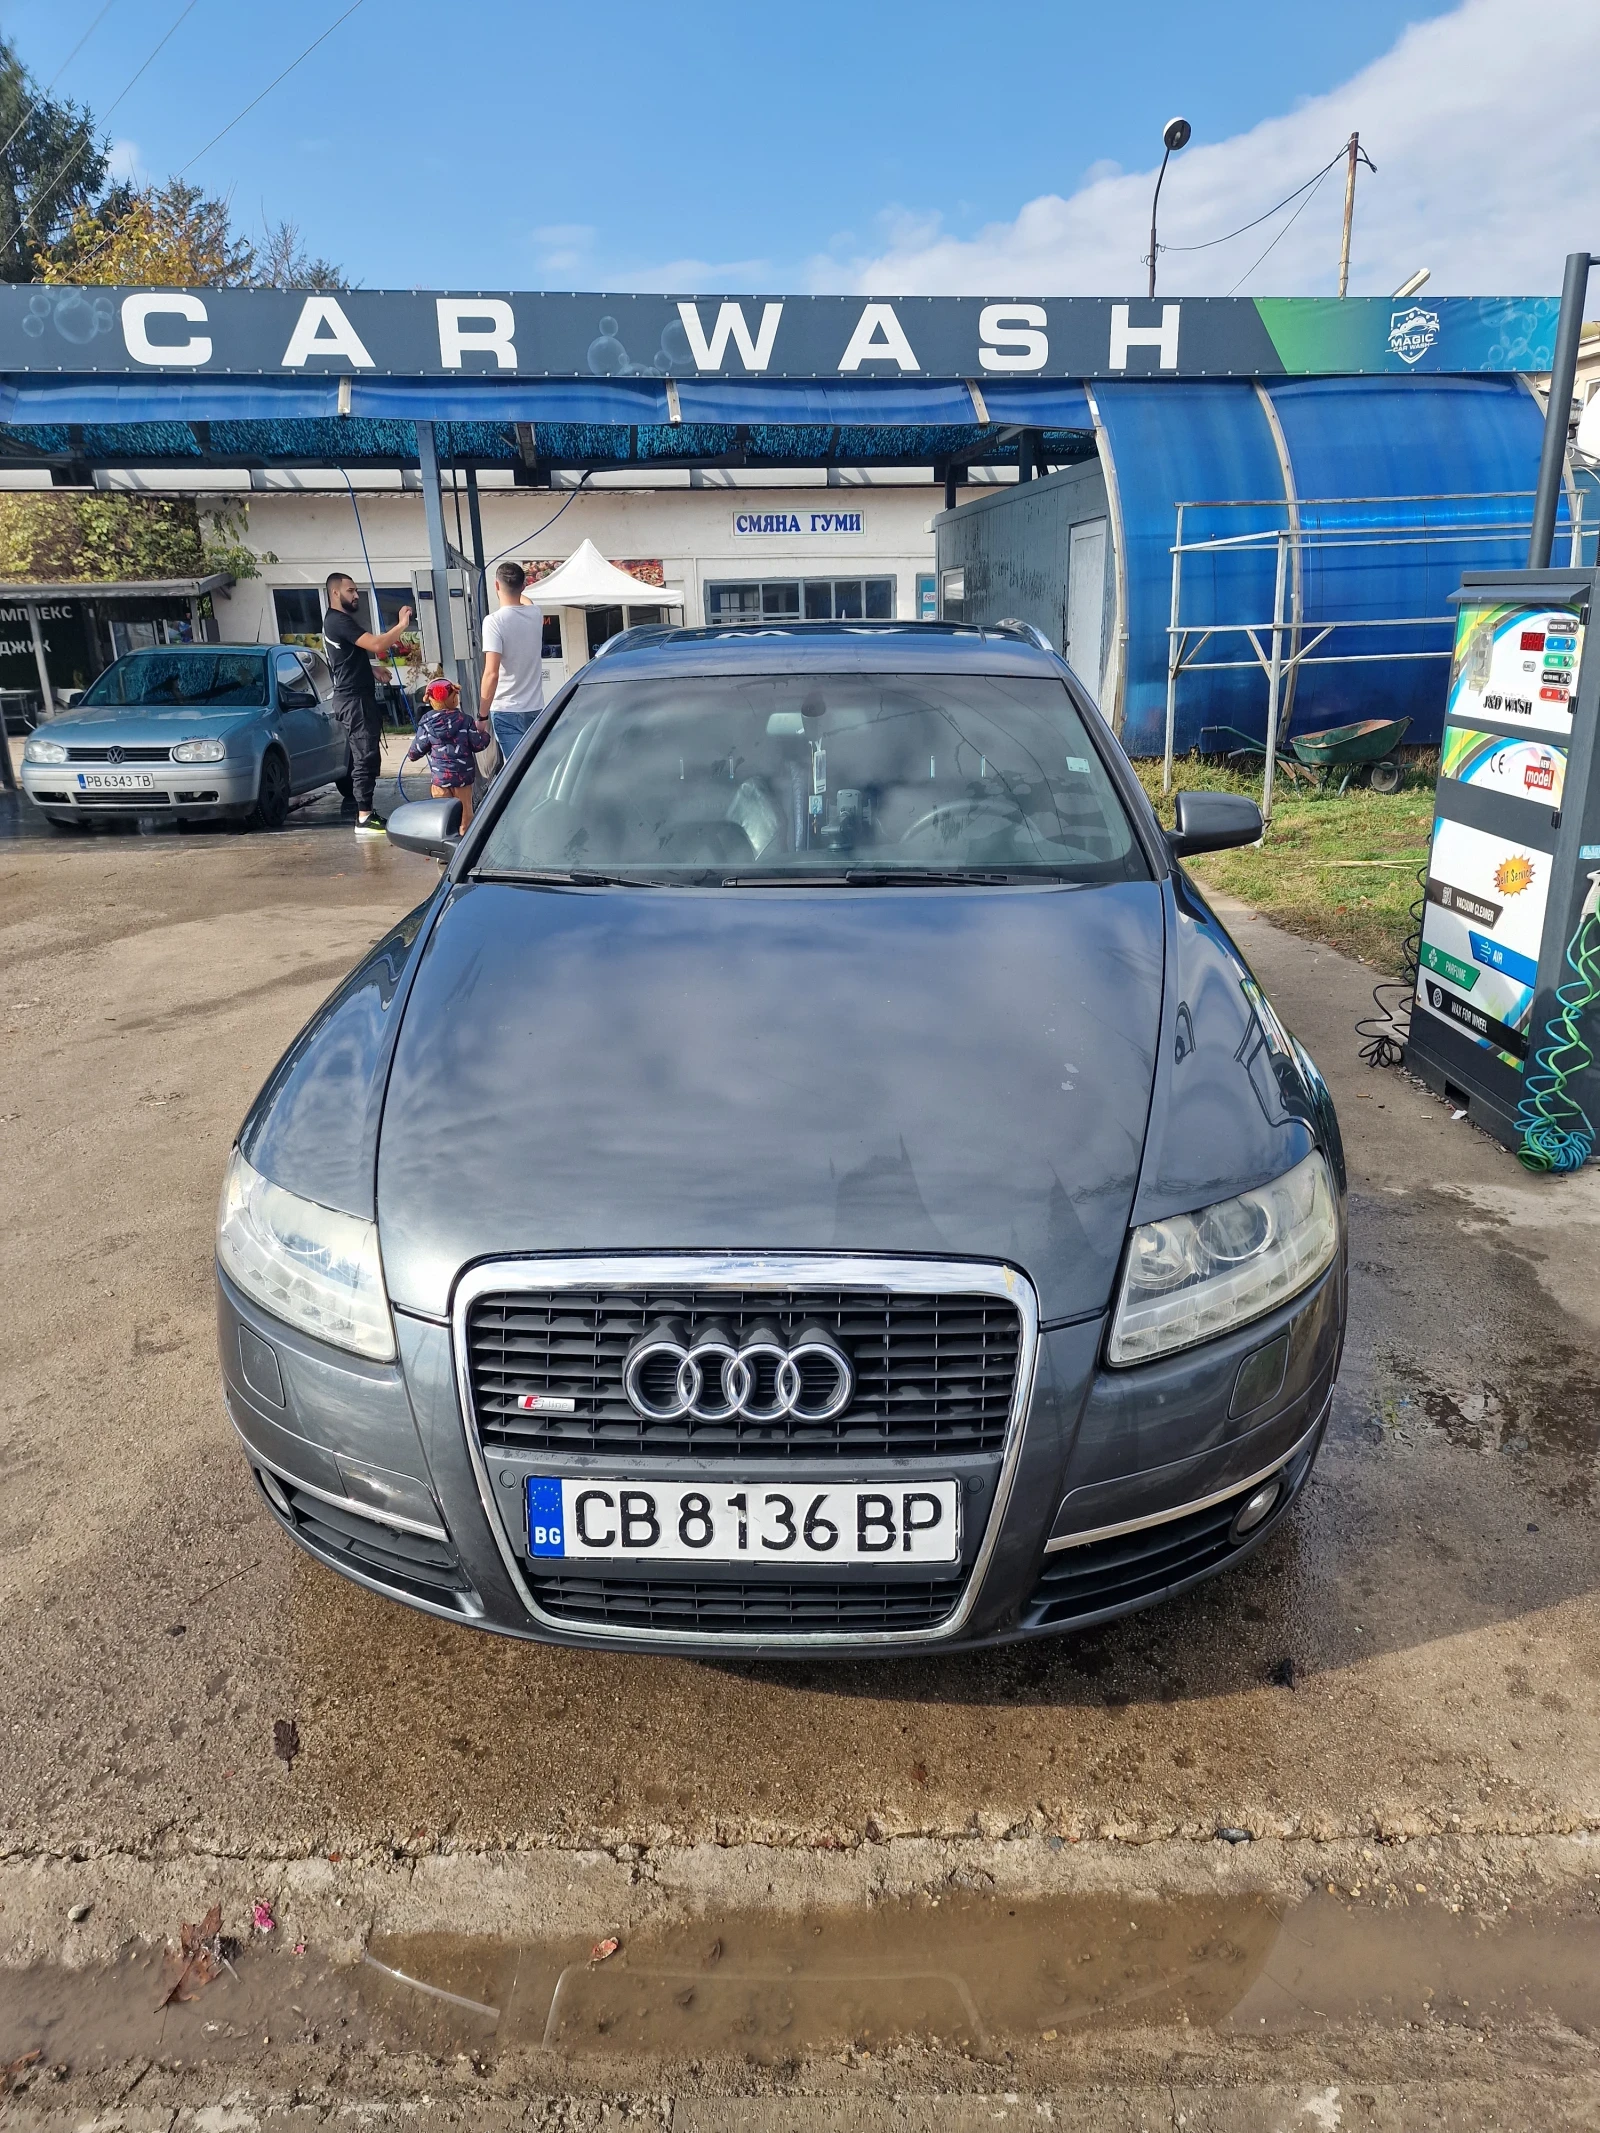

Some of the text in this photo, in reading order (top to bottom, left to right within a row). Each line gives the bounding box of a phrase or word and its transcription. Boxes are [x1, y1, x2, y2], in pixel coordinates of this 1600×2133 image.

[121, 292, 1181, 371] CAR WASH
[1391, 333, 1434, 347] MAGIC
[736, 513, 861, 532] СМЯНА ГУМИ
[1504, 697, 1533, 715] WASH
[1540, 760, 1551, 770] NEW
[86, 775, 151, 787] PB 6343 TB
[1526, 770, 1553, 787] model
[1496, 867, 1534, 886] Self Service
[1456, 896, 1495, 922] VACUUM CLEANER
[1492, 950, 1503, 965] AIR
[1445, 961, 1467, 981] PARFUME
[1451, 1001, 1488, 1033] WAX FOR WHEEL
[575, 1490, 942, 1552] CB 8136 BP
[534, 1526, 561, 1544] BG
